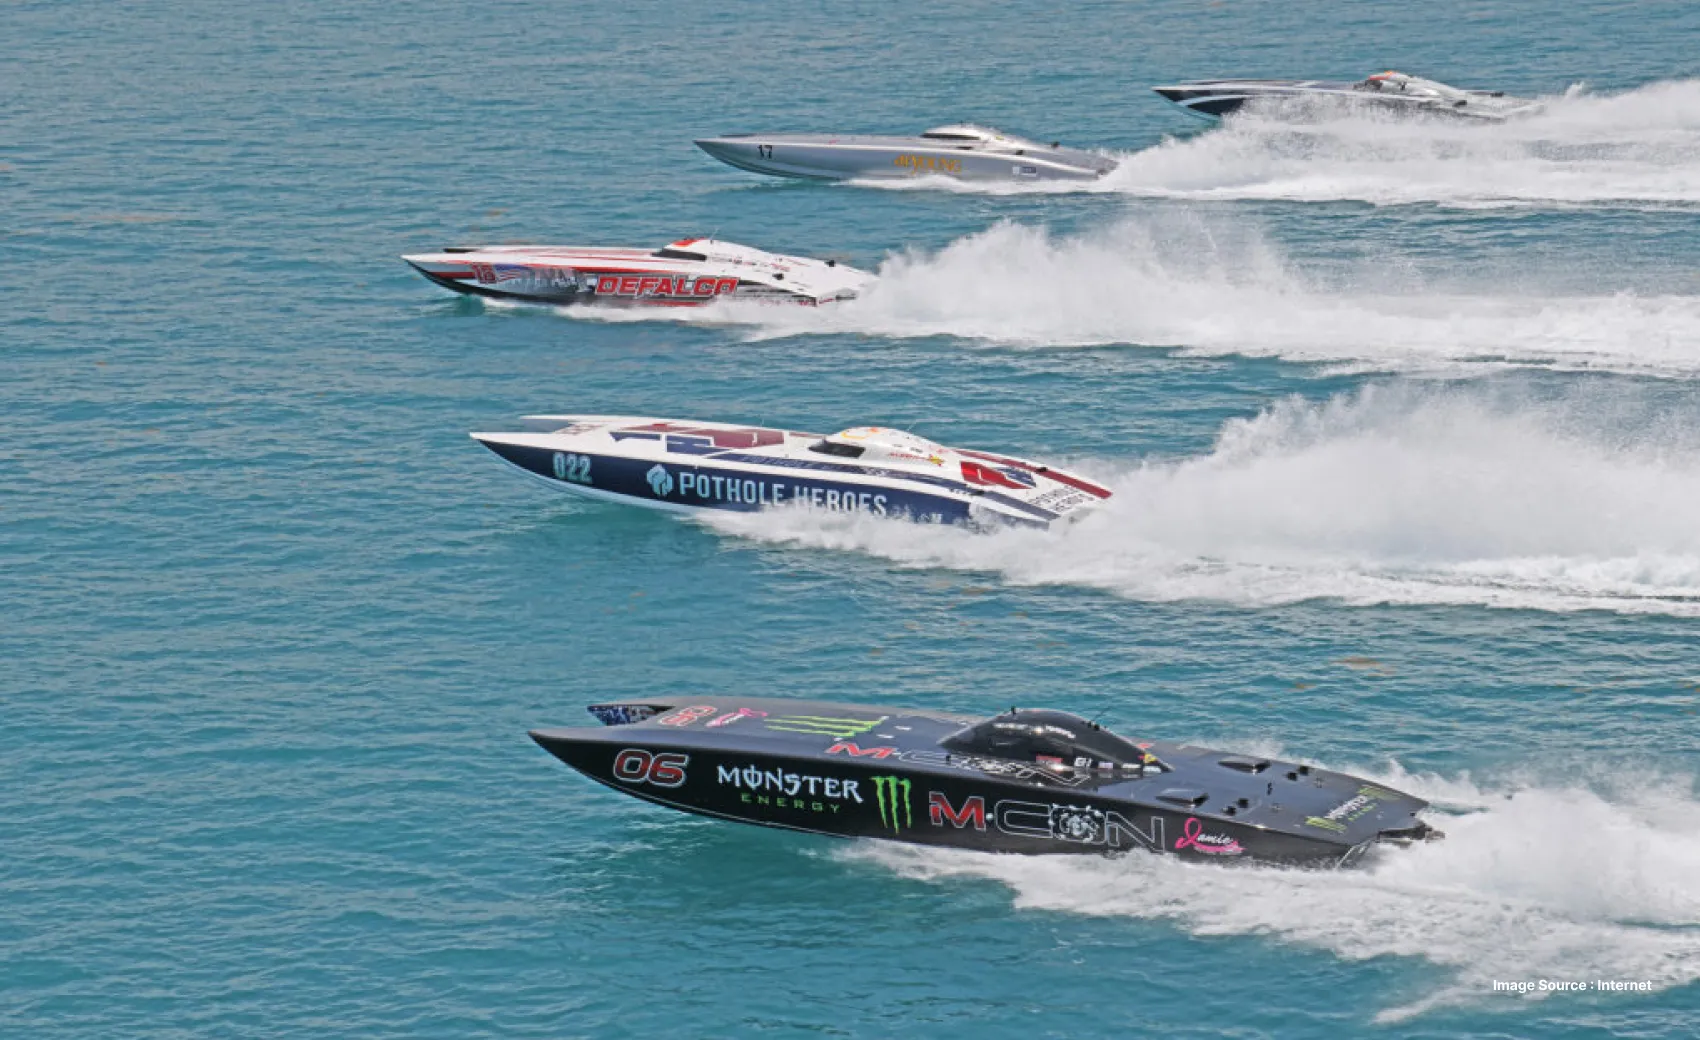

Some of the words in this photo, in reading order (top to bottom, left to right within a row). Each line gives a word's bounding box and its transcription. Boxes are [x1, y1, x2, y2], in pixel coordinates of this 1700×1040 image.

[757, 144, 773, 160] 17
[595, 275, 739, 298] DEFALCO
[552, 451, 593, 484] 022
[679, 472, 785, 507] POTHOLE
[793, 485, 888, 517] HEROES
[613, 748, 690, 788] 06
[716, 764, 864, 804] MONSTER
[740, 792, 841, 814] ENERGY
